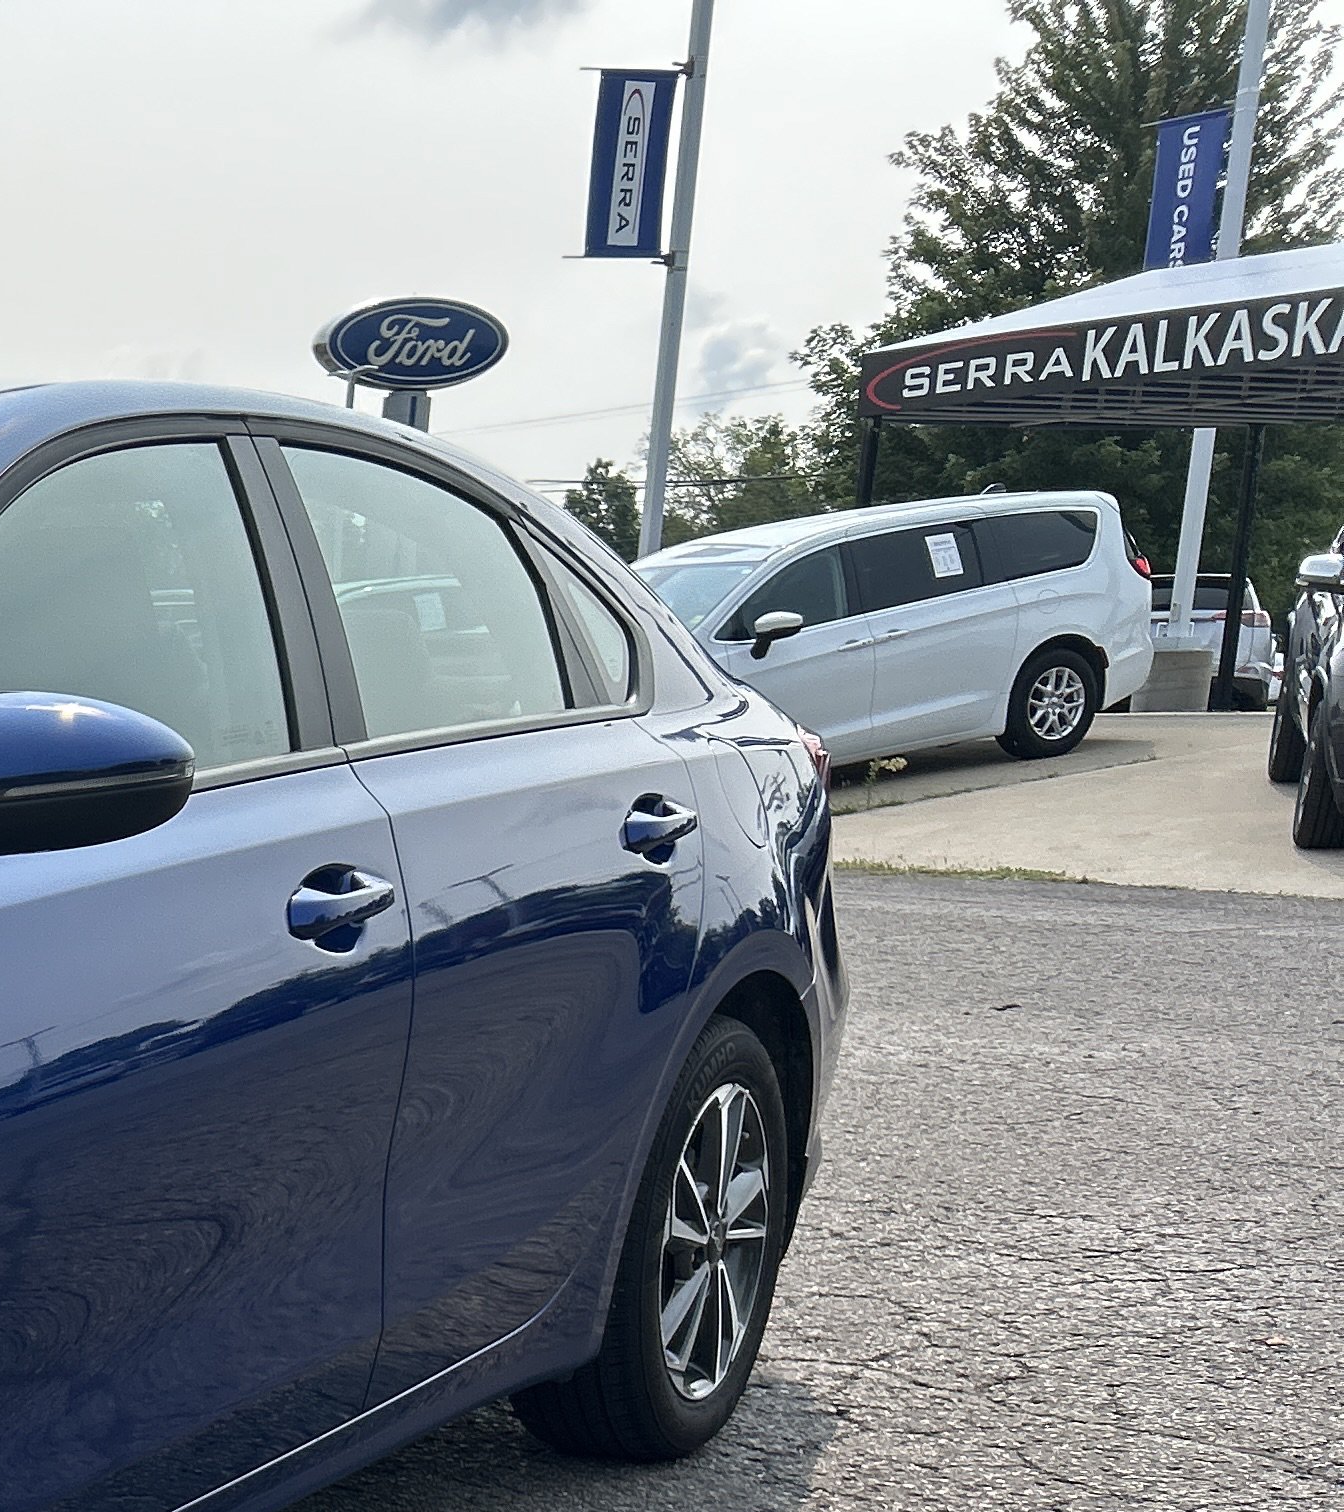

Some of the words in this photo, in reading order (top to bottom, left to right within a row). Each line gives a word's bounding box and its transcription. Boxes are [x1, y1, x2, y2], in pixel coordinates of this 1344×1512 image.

[615, 116, 641, 234] SERRA
[1176, 125, 1201, 199] USED
[367, 314, 476, 367] Ford
[902, 347, 1074, 398] SERRA
